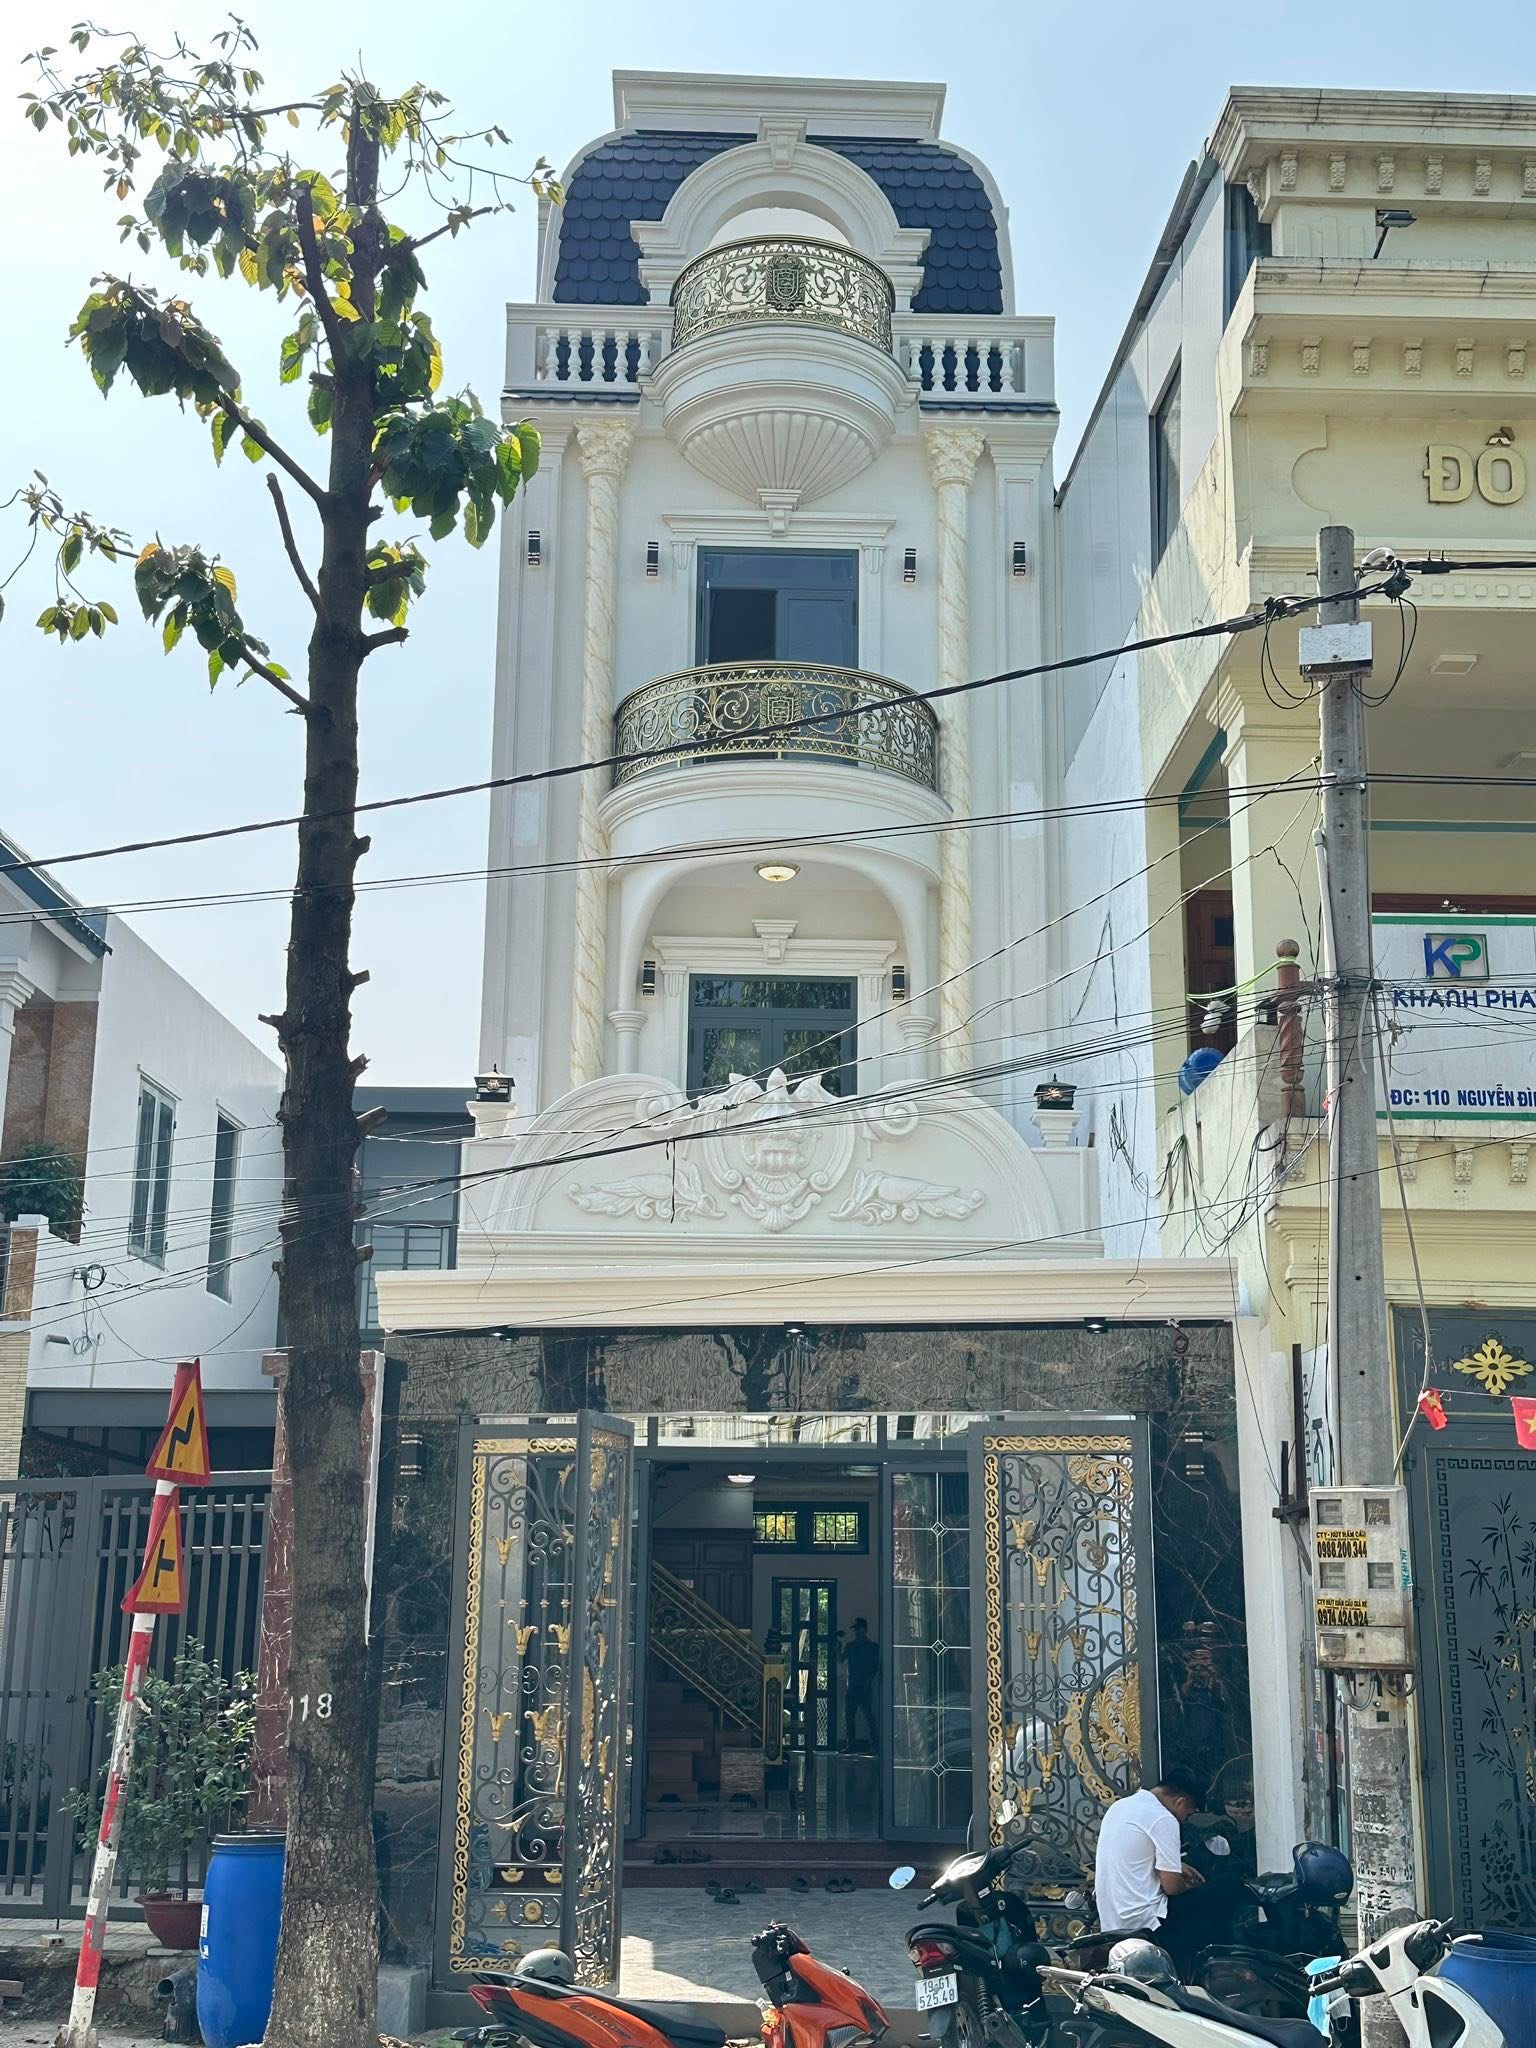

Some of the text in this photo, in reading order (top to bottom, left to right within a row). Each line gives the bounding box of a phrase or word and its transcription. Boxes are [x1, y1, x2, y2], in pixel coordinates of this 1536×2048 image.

[1425, 938, 1481, 977] KP
[1485, 989, 1536, 1008] PHA
[1390, 1088, 1420, 1106] ĐC:
[1424, 1089, 1450, 1106] 110
[1457, 1084, 1515, 1107] NGUYỄN
[289, 1692, 333, 1722] 118
